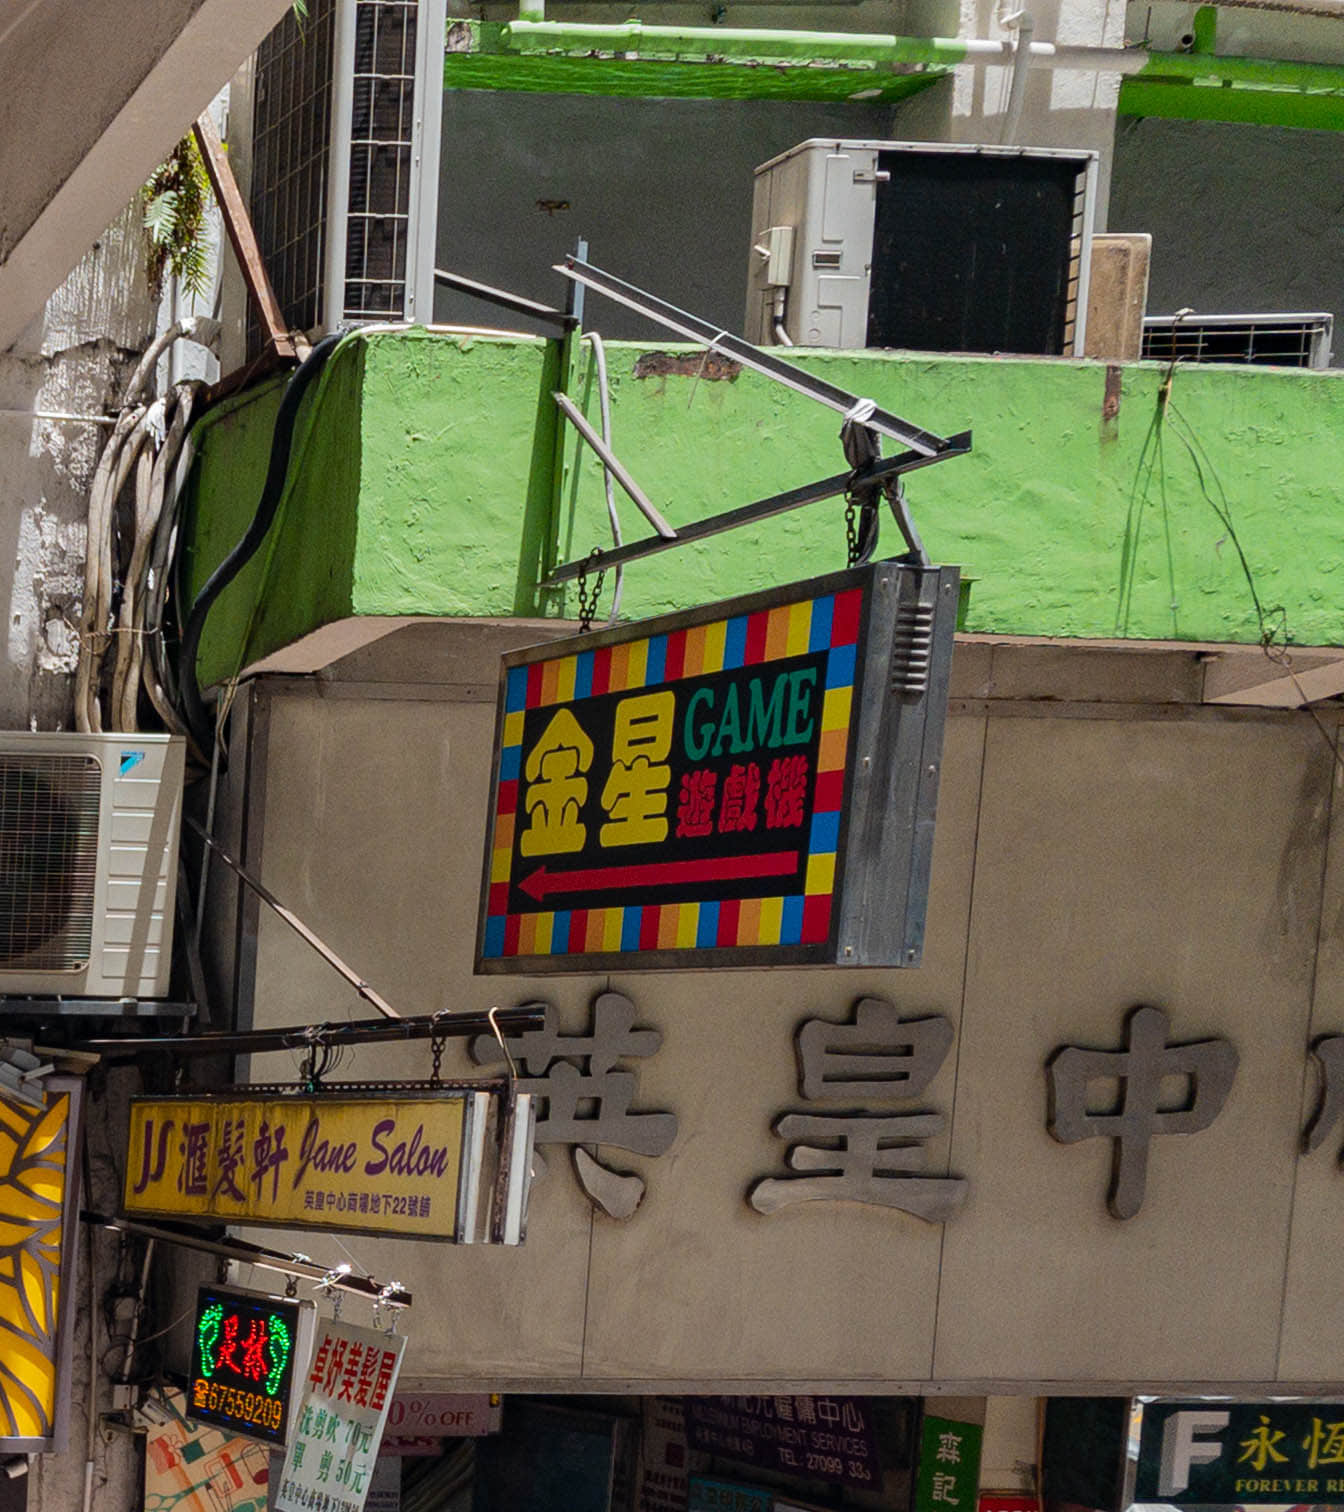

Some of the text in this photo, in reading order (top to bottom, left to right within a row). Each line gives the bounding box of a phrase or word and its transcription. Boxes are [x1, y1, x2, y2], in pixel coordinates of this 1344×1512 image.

[683, 668, 817, 762] GAME
[520, 691, 676, 857] 金星
[675, 754, 810, 842] 遊戲機
[470, 991, 1344, 1226] 英皇中
[292, 1117, 360, 1191] Jane
[364, 1118, 450, 1179] Salon
[208, 1382, 283, 1430] 67559209
[439, 1411, 474, 1427] OFF
[1158, 1410, 1231, 1497] F
[1234, 1478, 1319, 1494] FOREVER
